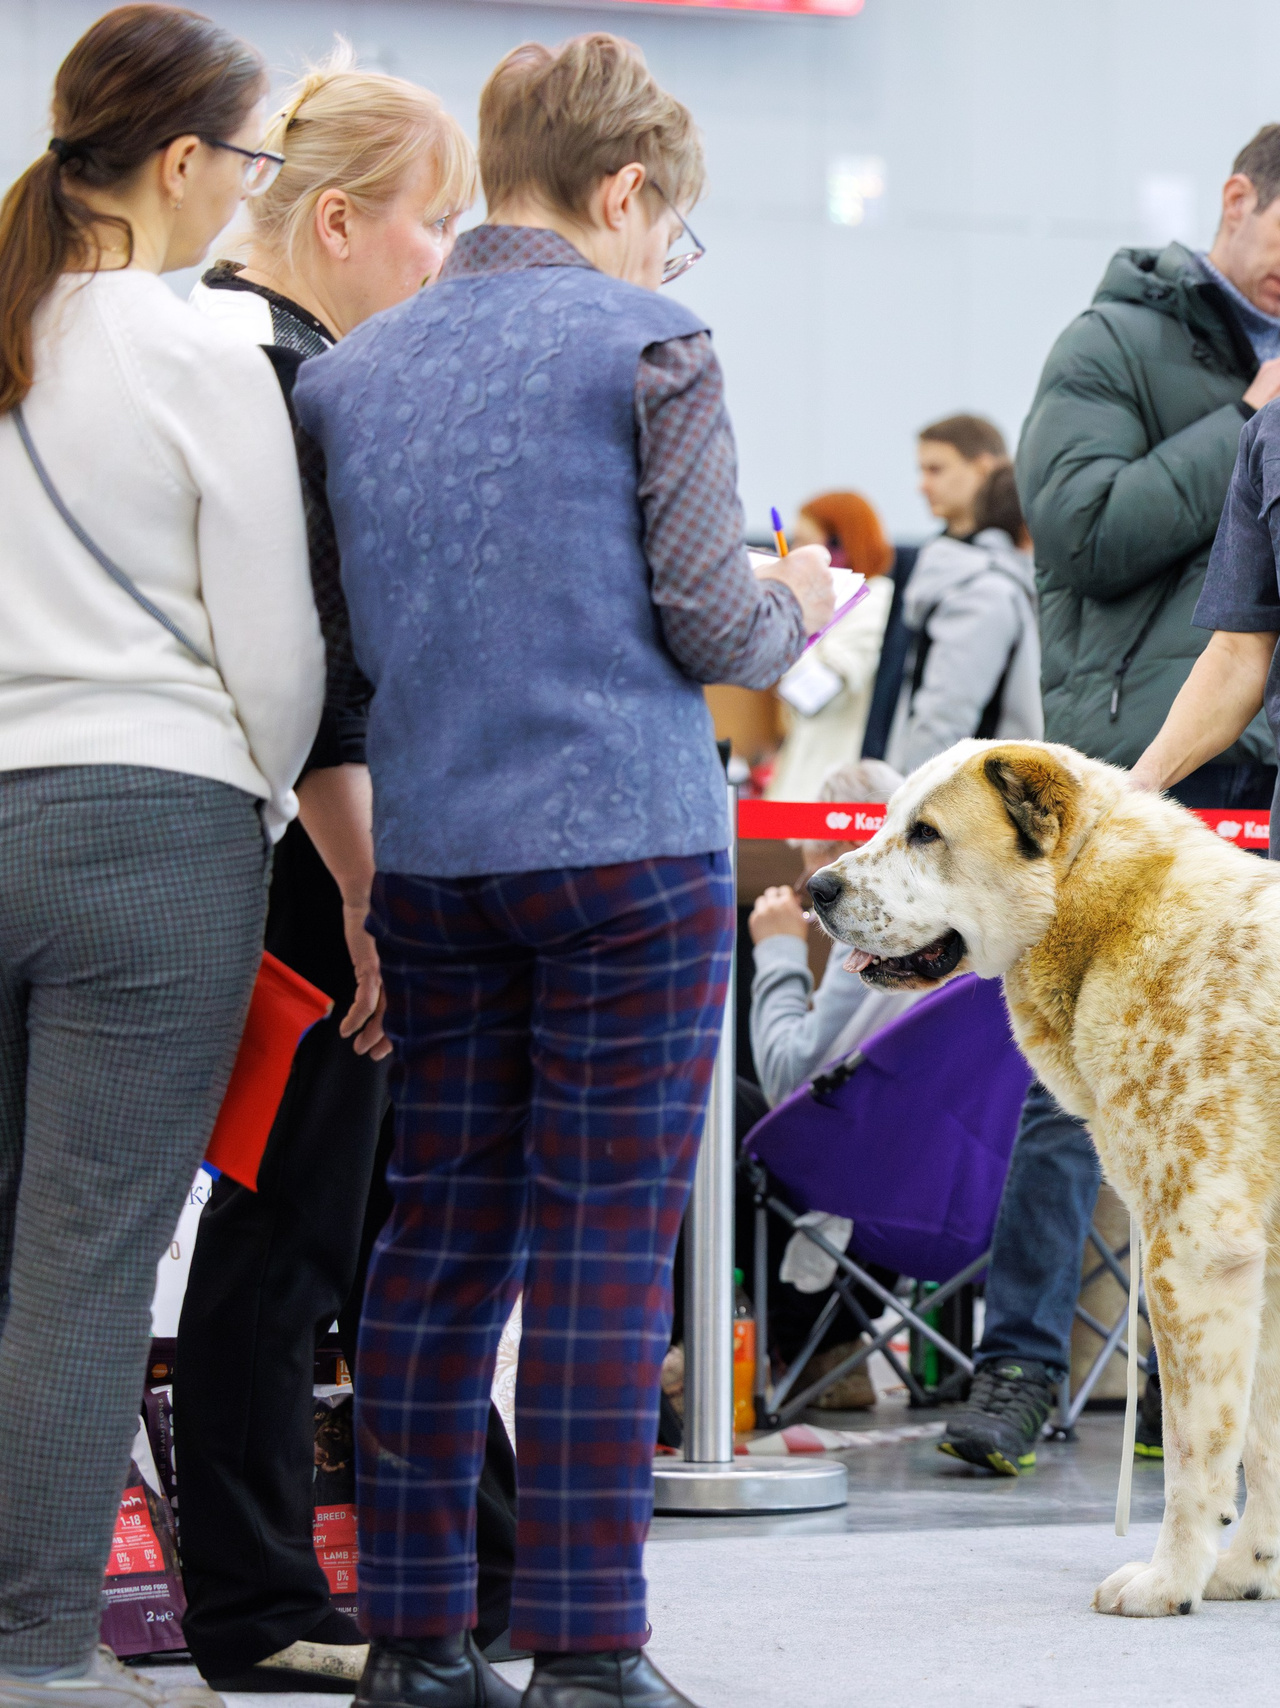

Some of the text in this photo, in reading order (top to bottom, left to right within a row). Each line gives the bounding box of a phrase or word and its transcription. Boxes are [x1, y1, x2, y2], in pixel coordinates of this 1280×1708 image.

[317, 1511, 346, 1522] BREED
[116, 1552, 130, 1564] 0%
[144, 1549, 157, 1561] 0%
[323, 1551, 349, 1560] LAMB
[336, 1570, 349, 1582] 0%
[146, 1610, 155, 1623] 2
